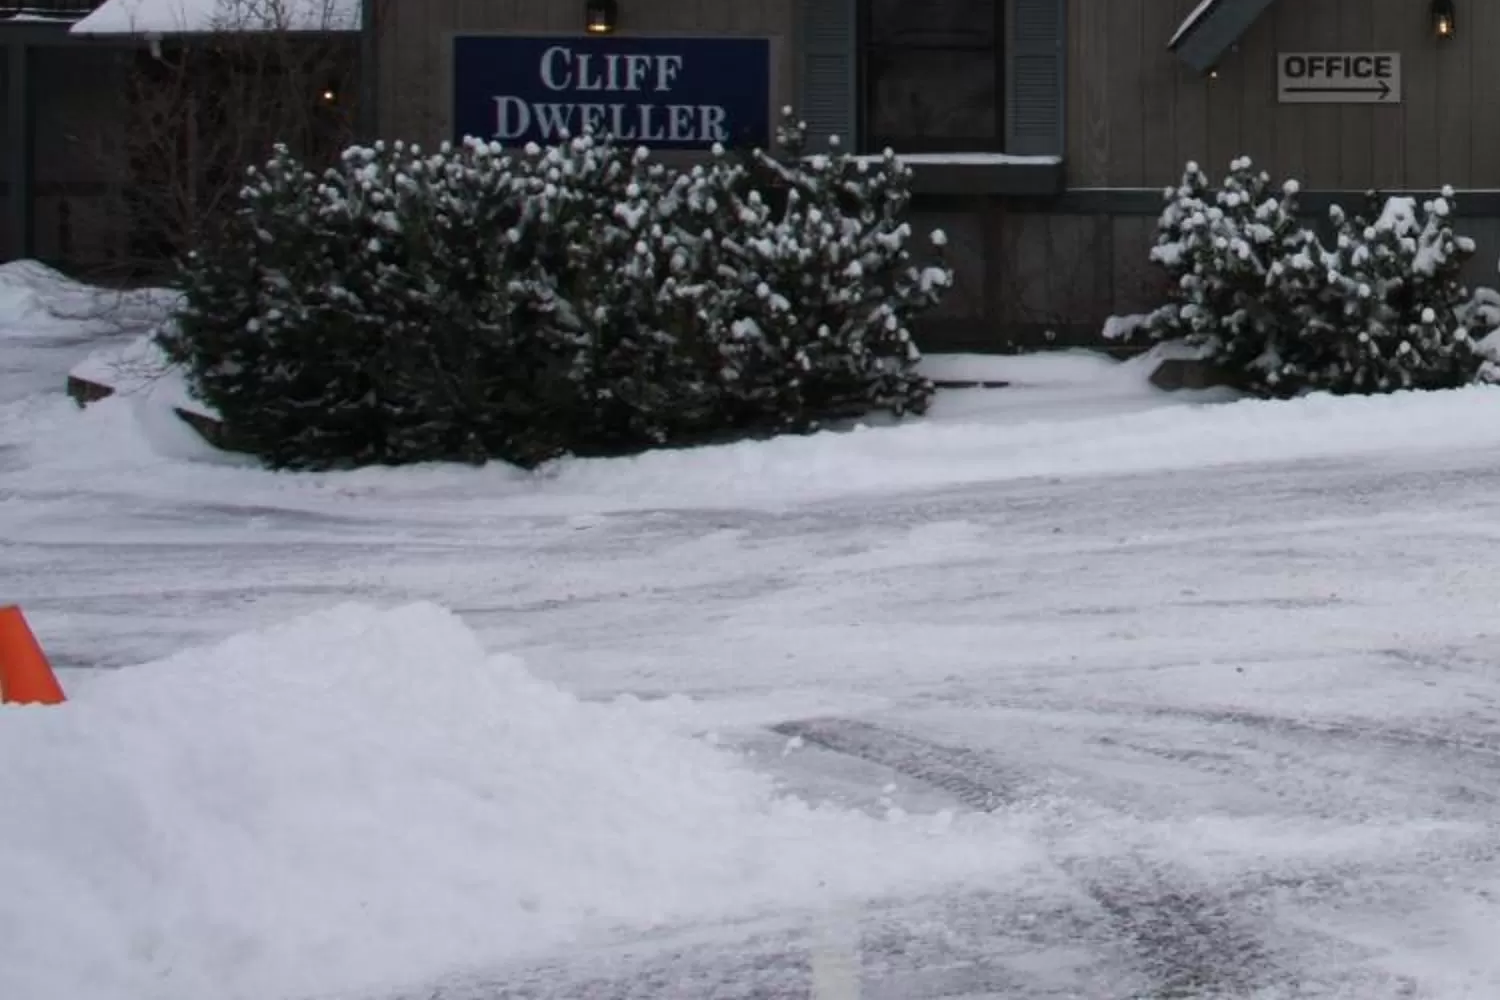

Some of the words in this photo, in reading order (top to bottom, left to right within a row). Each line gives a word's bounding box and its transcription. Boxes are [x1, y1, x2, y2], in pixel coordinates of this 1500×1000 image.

[540, 46, 683, 91] CLIFF
[1284, 55, 1393, 79] OFFICE
[493, 96, 729, 141] DWELLER
